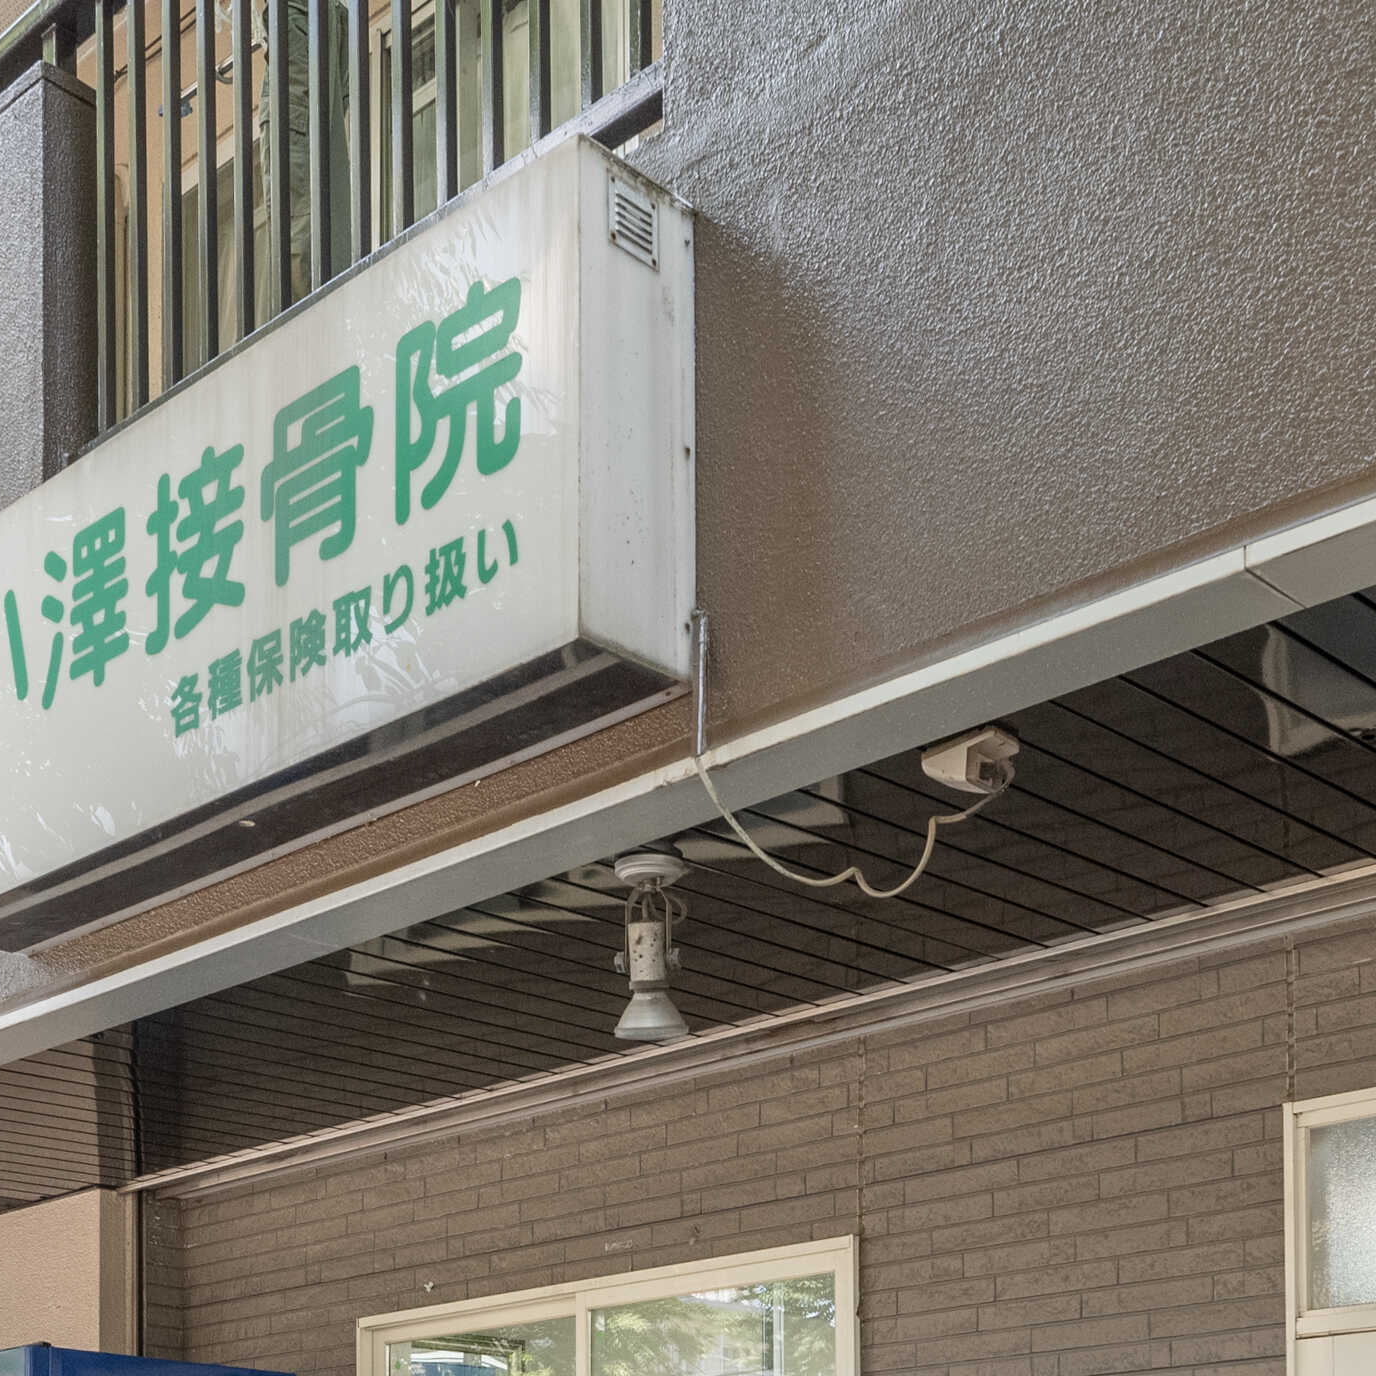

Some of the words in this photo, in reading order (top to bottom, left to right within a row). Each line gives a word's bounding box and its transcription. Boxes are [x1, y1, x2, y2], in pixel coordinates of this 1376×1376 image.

[171, 519, 519, 738] 各種保険取り扱い
